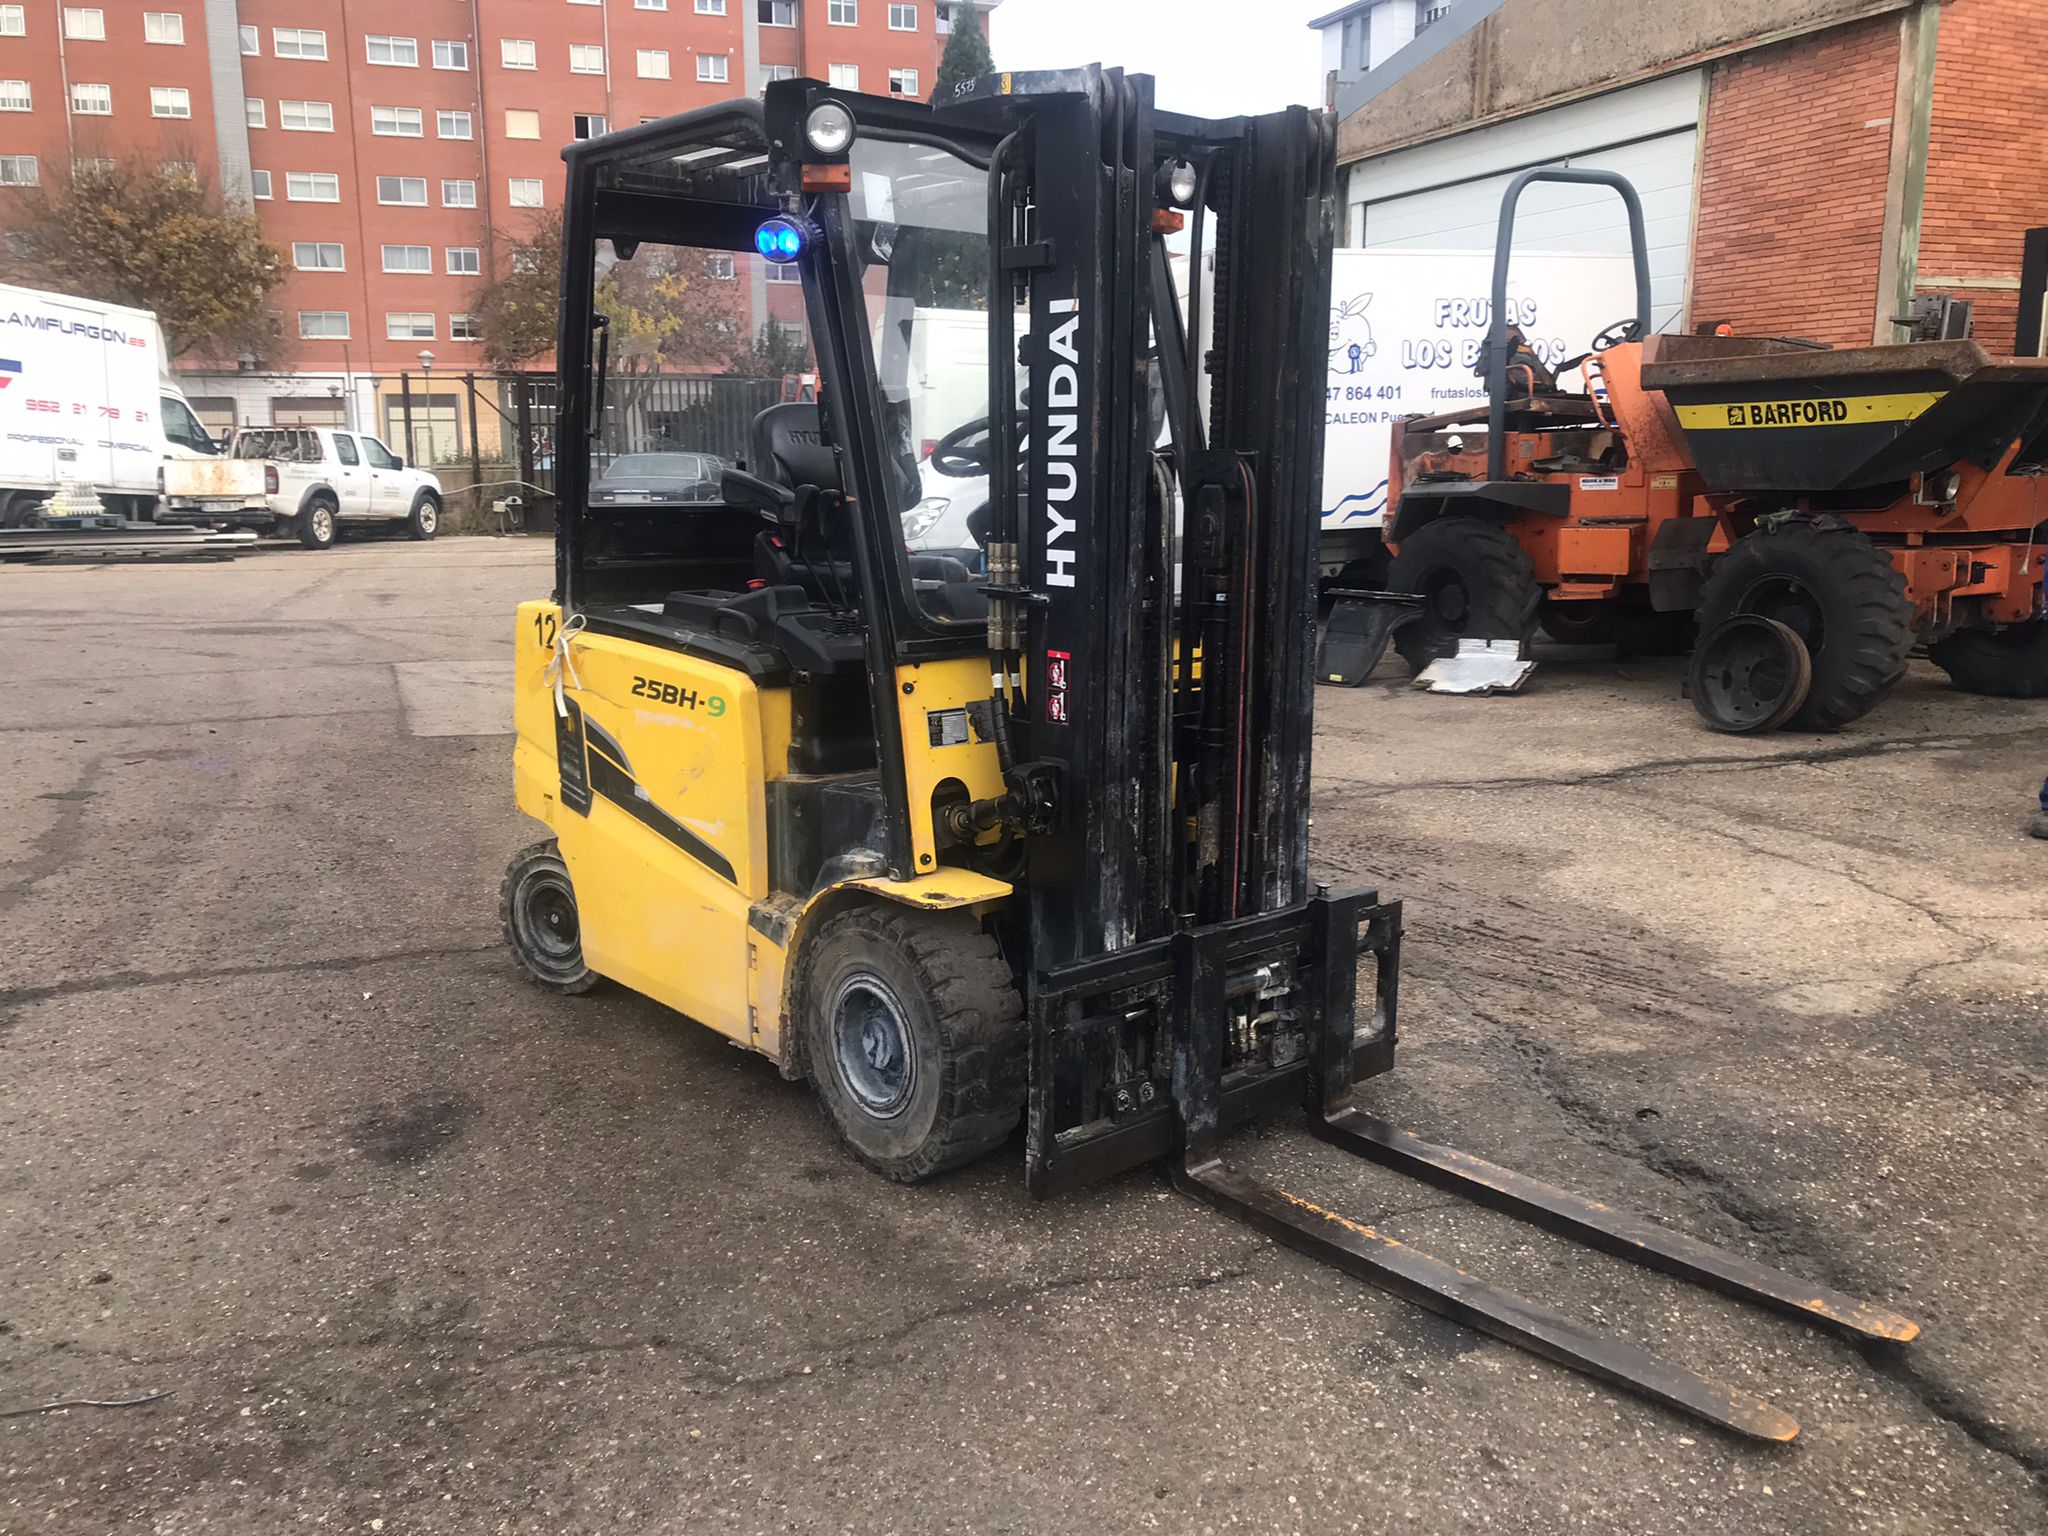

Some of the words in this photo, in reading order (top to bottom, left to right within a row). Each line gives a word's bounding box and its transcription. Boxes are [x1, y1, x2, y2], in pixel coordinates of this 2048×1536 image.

[1435, 297, 1537, 328] FRUAS
[1401, 339, 1452, 369] LOS
[1345, 386, 1373, 401] 864
[1376, 385, 1402, 400] 401
[25, 399, 60, 414] 952
[72, 403, 87, 416] 21
[135, 410, 150, 423] 21
[1381, 411, 1406, 424] Pue
[1750, 400, 1848, 425] BARFORD
[1046, 298, 1079, 588] HYUNDAI
[534, 612, 557, 650] 12
[631, 676, 726, 718] 25BH-9
